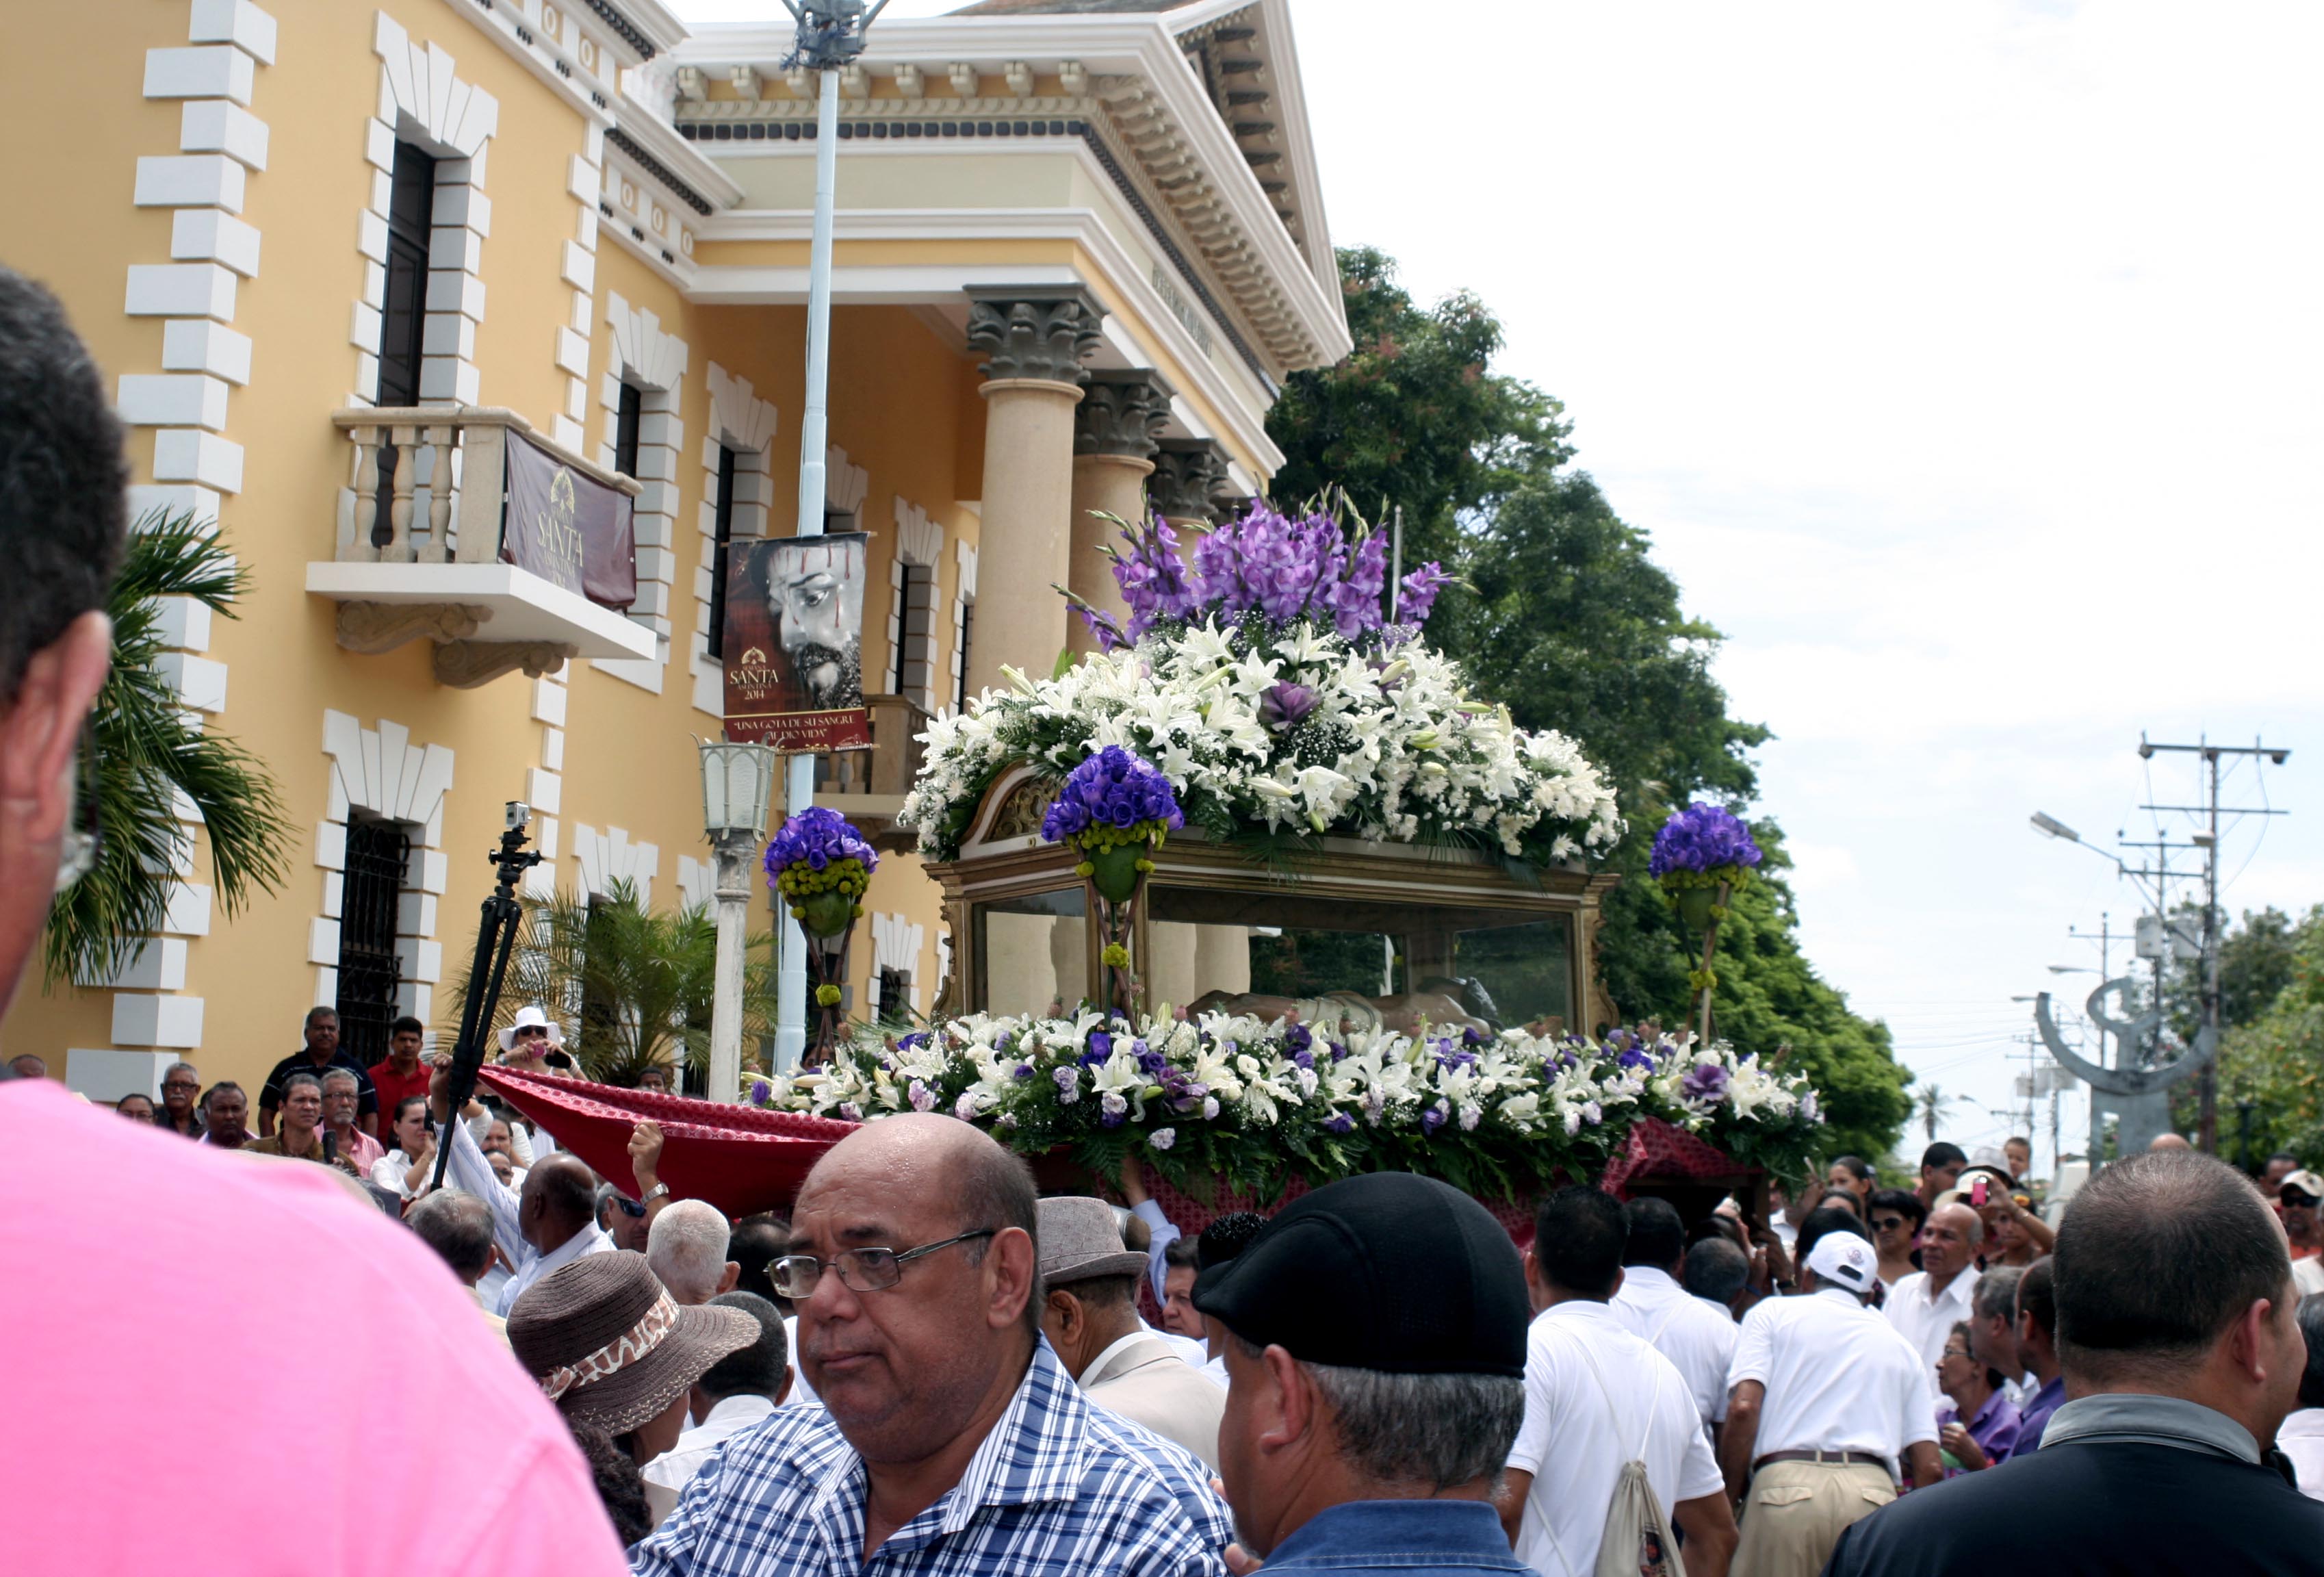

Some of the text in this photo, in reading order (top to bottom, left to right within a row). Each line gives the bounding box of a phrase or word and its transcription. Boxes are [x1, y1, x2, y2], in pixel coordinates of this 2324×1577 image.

[537, 511, 583, 567] SANTA
[730, 669, 779, 684] SANTA
[744, 689, 764, 700] 2014
[760, 719, 787, 730] GOTA
[788, 718, 802, 728] DE
[804, 717, 816, 727] SU
[818, 715, 855, 726] SANGRE
